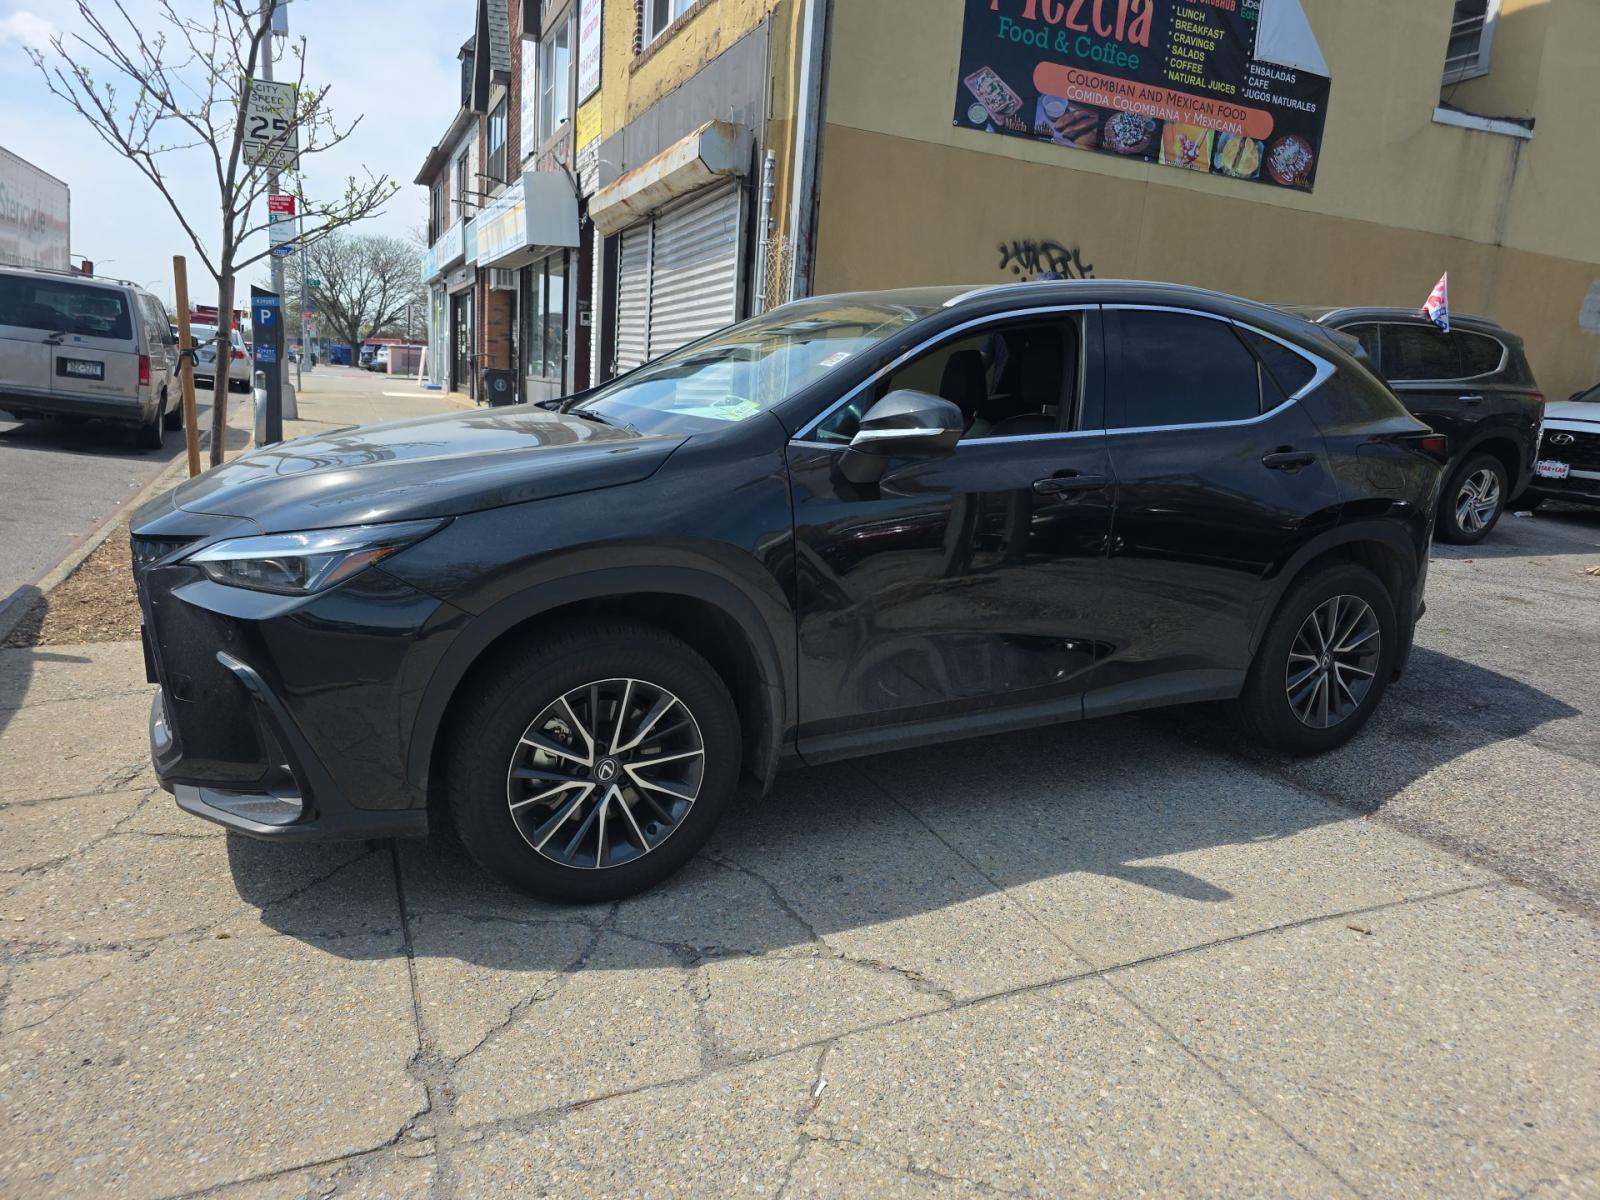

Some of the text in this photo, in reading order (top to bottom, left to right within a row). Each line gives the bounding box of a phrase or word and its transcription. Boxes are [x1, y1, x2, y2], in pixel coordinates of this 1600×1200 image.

[989, 0, 1154, 48] zcla
[1176, 7, 1206, 22] LUNCH
[1175, 19, 1225, 40] BREAKFAST
[997, 16, 1140, 70] Food & Coffee
[1173, 32, 1215, 51] CRAVINGS
[1171, 45, 1205, 61] SALADS
[1170, 59, 1203, 74] COFFEE
[1250, 64, 1296, 84] ENSALADAS
[256, 84, 278, 94] CITY
[1168, 71, 1236, 94] NATURAL JUICES
[1248, 77, 1270, 90] CAFE
[1067, 70, 1247, 121] COLOMBIAN AND MEXICAN FOOD
[1244, 88, 1316, 113] JUGOS NATURALES
[1067, 85, 1109, 105] COMIDA
[1113, 96, 1180, 121] COLOMBIANA
[1193, 114, 1243, 134] MEXICANA
[250, 116, 290, 142] 25
[261, 309, 271, 324] P
